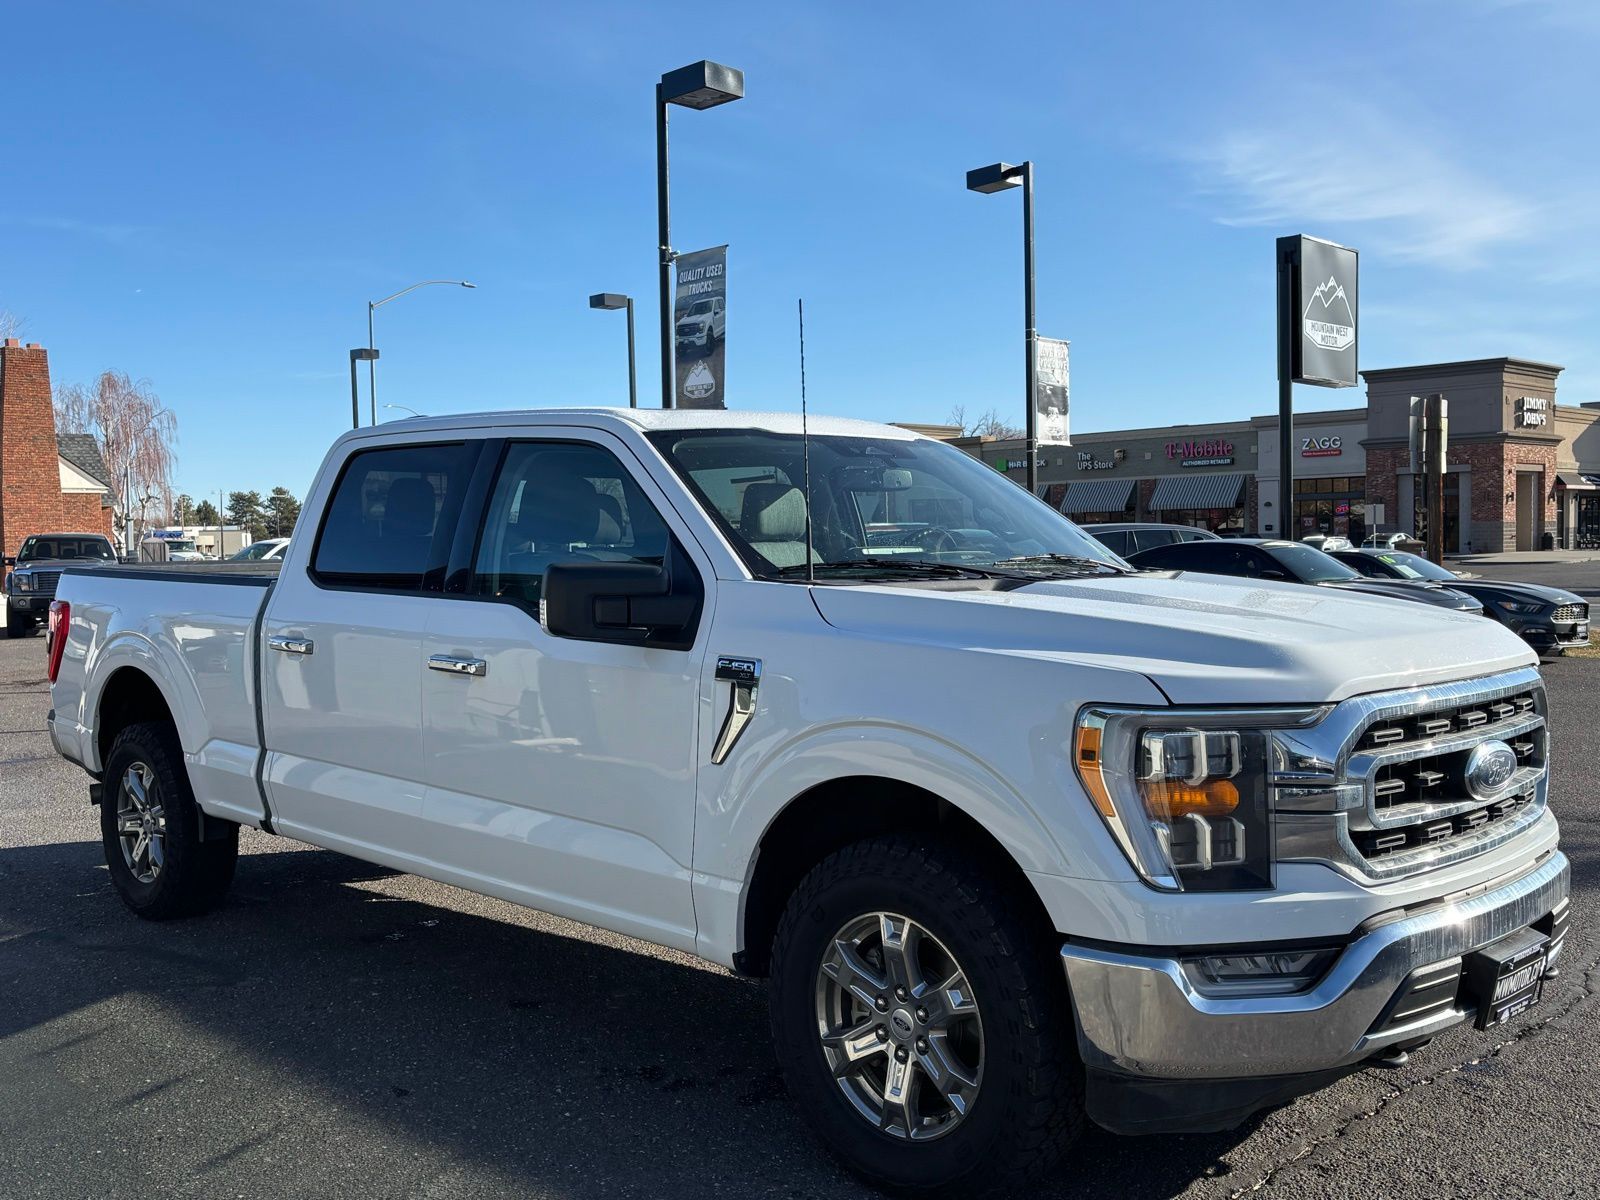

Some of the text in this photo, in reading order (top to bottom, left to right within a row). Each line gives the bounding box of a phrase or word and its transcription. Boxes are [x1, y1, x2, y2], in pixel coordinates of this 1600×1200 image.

[679, 263, 723, 283] QUALITY USED
[688, 280, 713, 295] TRUCKS
[1310, 322, 1349, 337] MOUNTAIN WEST
[1320, 334, 1338, 345] MOTOR
[1523, 396, 1547, 410] JIMMY
[1523, 411, 1547, 426] JOHN'S
[1164, 440, 1233, 459] T-Mobile
[1302, 436, 1341, 450] ZAGG
[1022, 459, 1046, 467] BCK
[1077, 452, 1091, 461] The
[1077, 460, 1113, 471] UPS Store
[718, 660, 754, 672] F-150
[1488, 757, 1511, 784] Ford
